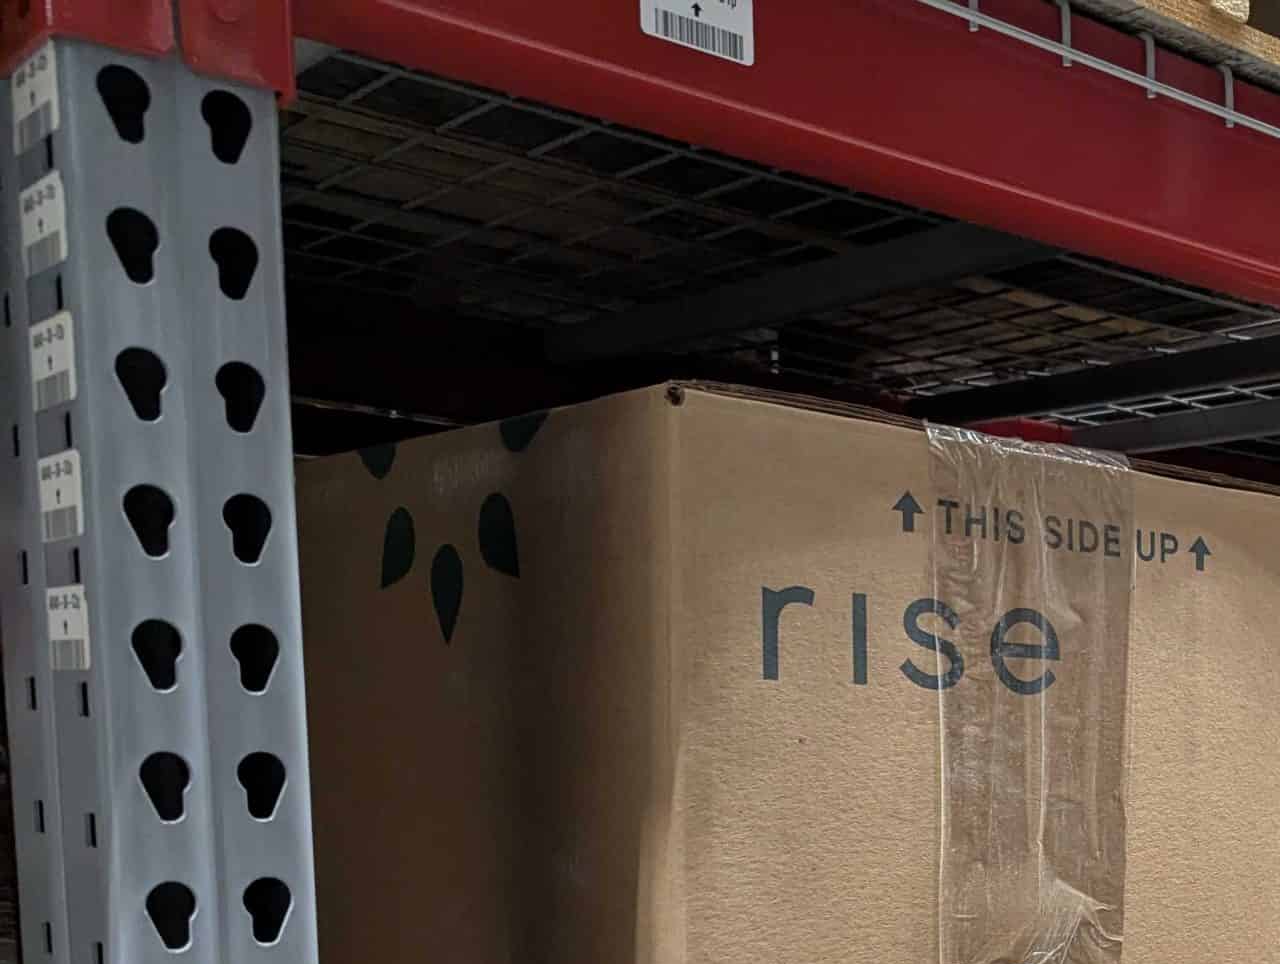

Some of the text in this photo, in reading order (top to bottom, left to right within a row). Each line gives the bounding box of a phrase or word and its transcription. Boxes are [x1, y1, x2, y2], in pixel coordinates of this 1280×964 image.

[937, 499, 1180, 564] THIS SIDE UP
[761, 584, 1061, 696] rise
